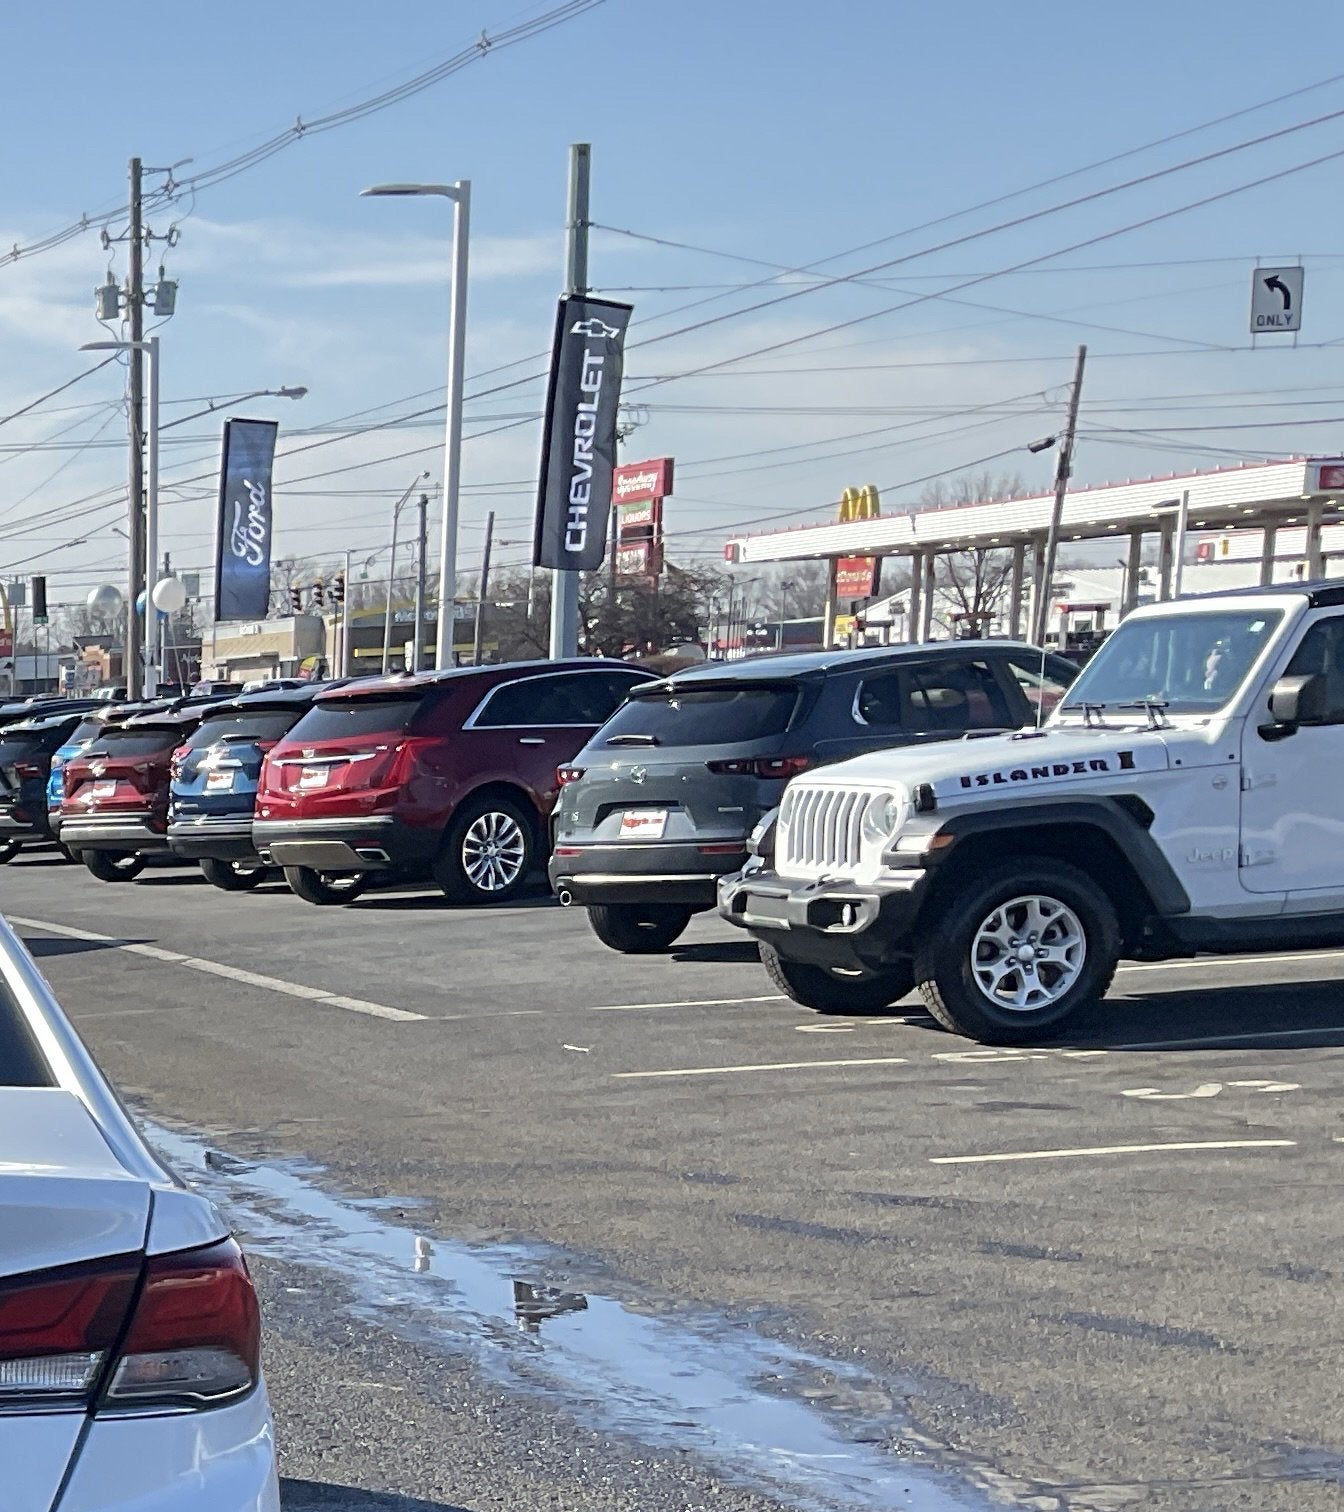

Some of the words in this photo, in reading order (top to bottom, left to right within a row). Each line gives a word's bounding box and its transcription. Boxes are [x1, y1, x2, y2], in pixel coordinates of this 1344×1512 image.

[1256, 313, 1293, 326] ONLY
[565, 349, 605, 552] CHEVROLET
[230, 479, 266, 566] Ford
[960, 759, 1110, 788] ISLANDER
[1187, 848, 1233, 863] Jeep
